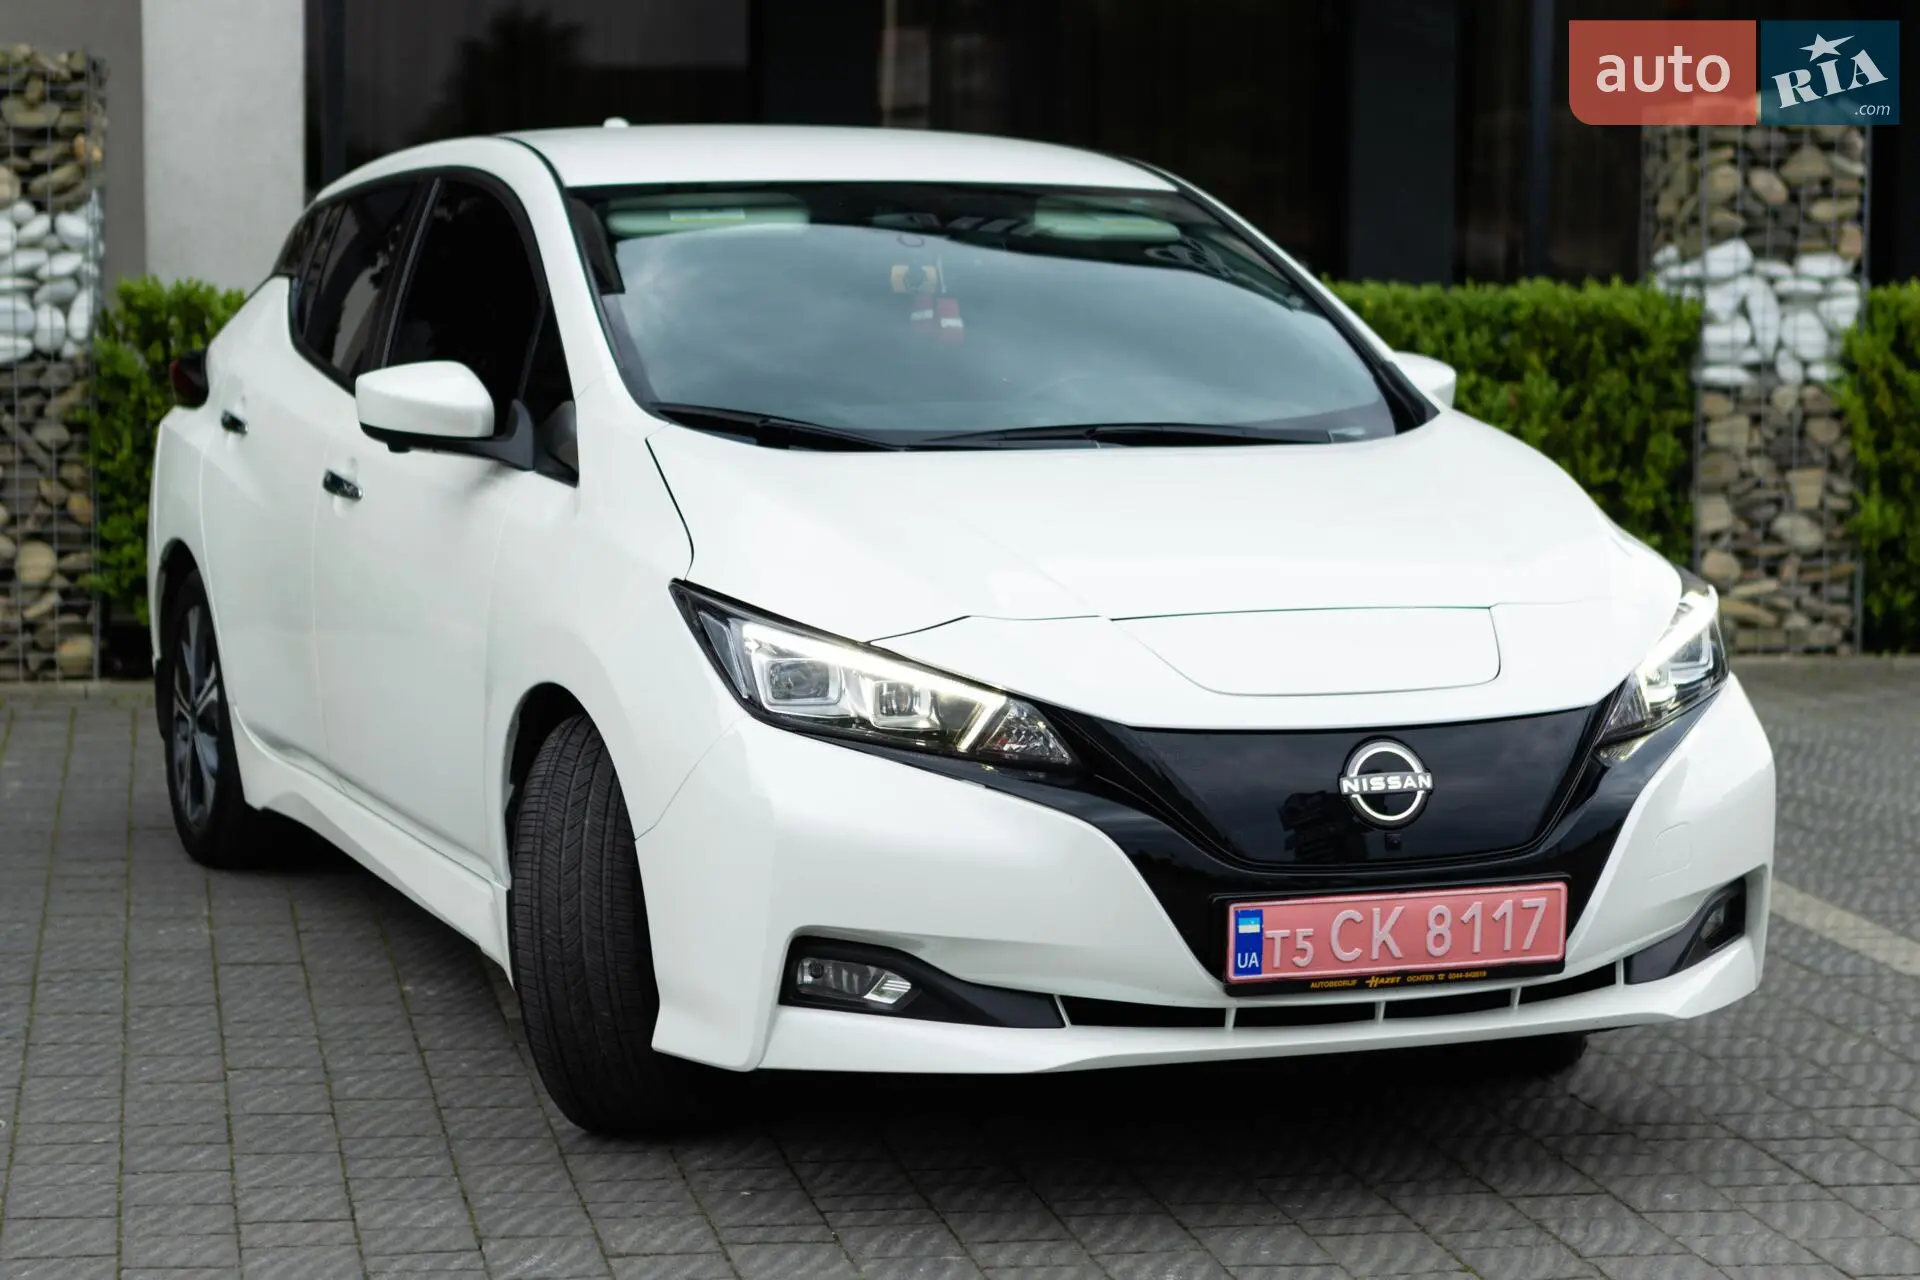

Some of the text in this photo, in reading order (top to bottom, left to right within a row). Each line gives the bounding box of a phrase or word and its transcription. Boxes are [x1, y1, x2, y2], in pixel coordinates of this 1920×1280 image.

[1342, 775, 1431, 793] NISSAN
[1265, 897, 1548, 968] T5 CK 8117
[1237, 952, 1259, 968] UA
[1364, 975, 1402, 988] HAZET
